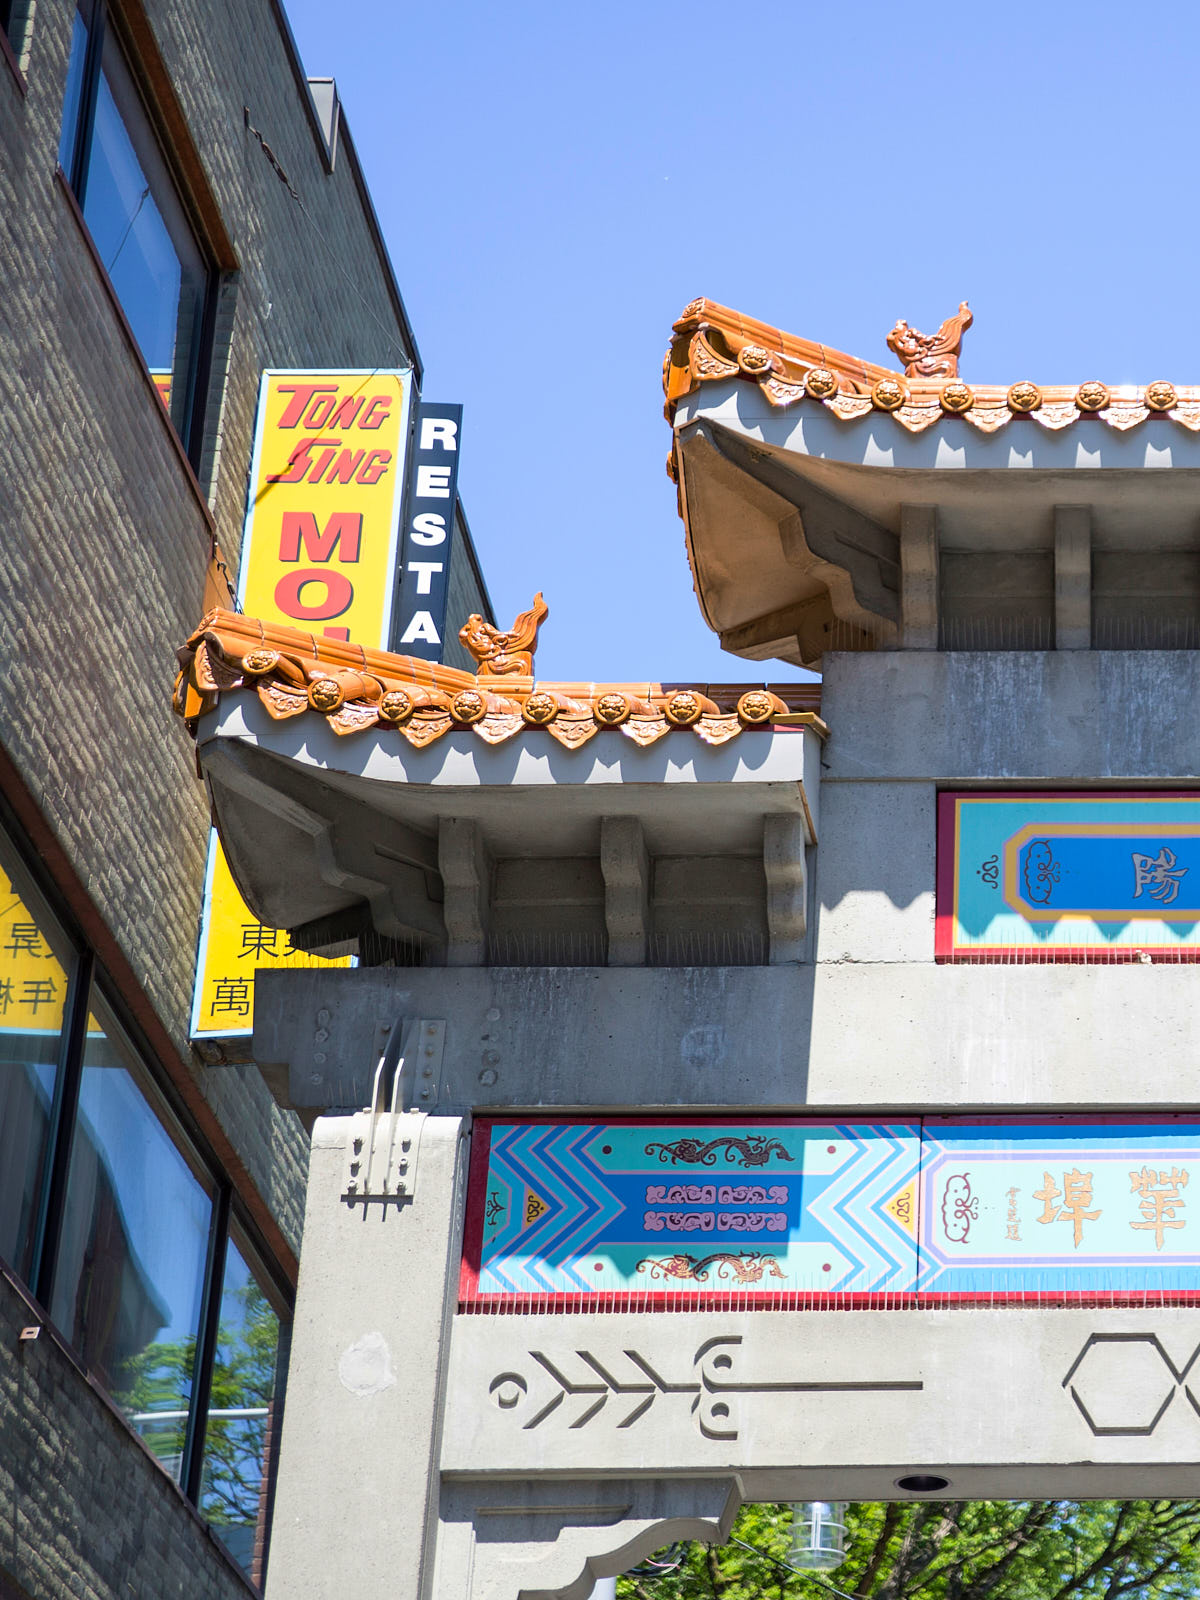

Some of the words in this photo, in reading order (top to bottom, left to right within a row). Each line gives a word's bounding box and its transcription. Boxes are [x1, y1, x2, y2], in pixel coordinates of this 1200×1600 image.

[276, 384, 393, 430] TONG
[265, 437, 393, 485] SING
[274, 511, 364, 643] MO
[400, 417, 458, 664] RESTA
